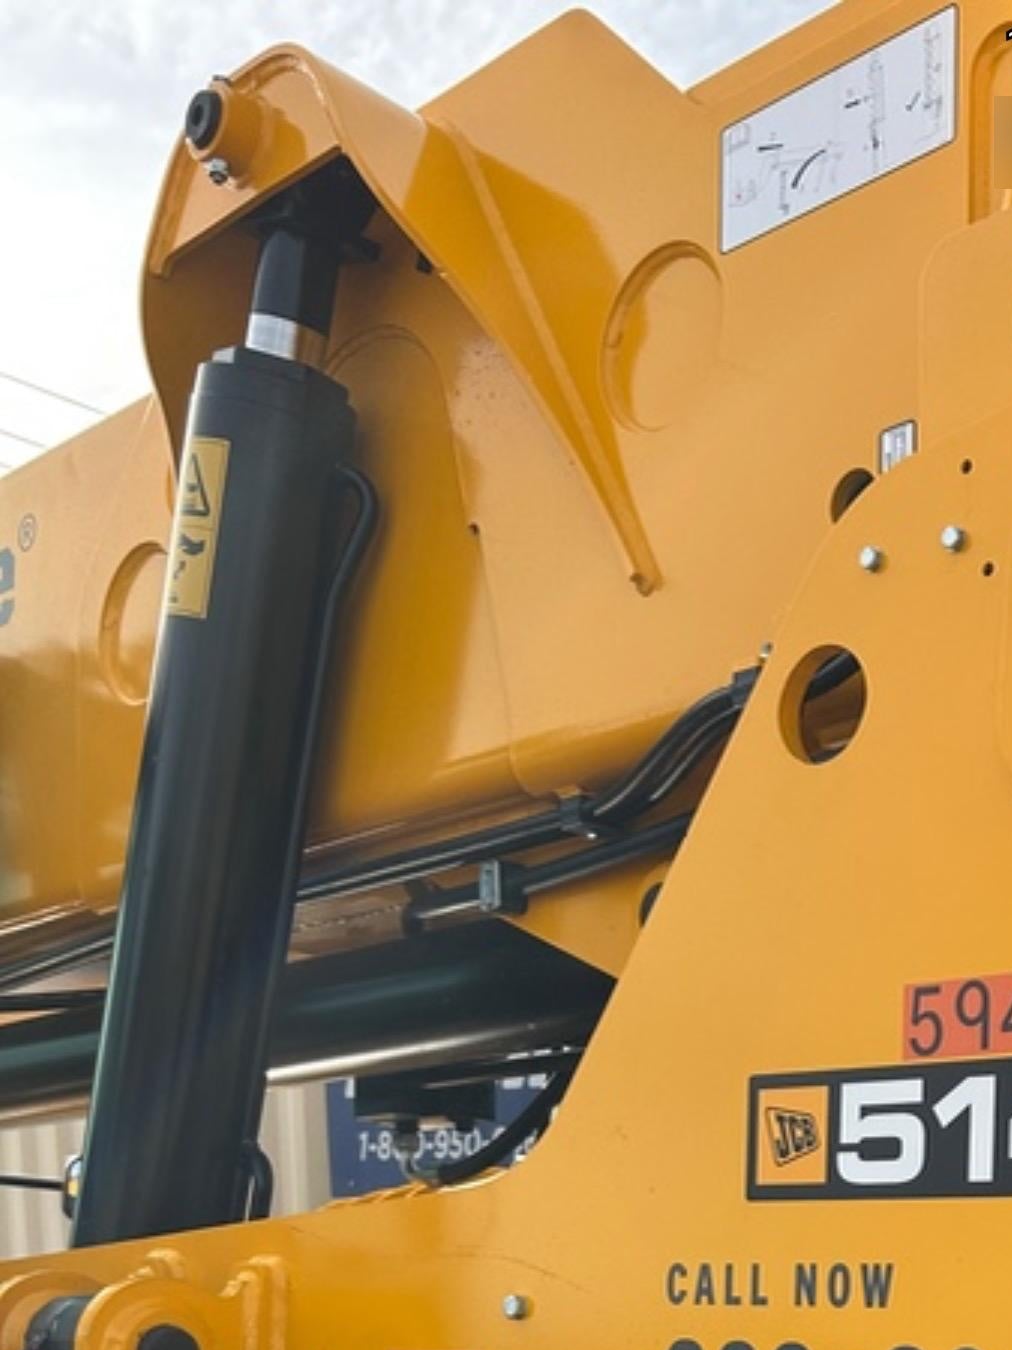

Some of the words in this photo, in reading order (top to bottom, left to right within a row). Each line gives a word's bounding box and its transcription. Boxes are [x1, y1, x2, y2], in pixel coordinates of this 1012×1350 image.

[766, 1108, 821, 1166] JCB
[666, 1262, 769, 1307] CALL
[793, 1263, 895, 1309] NOW
